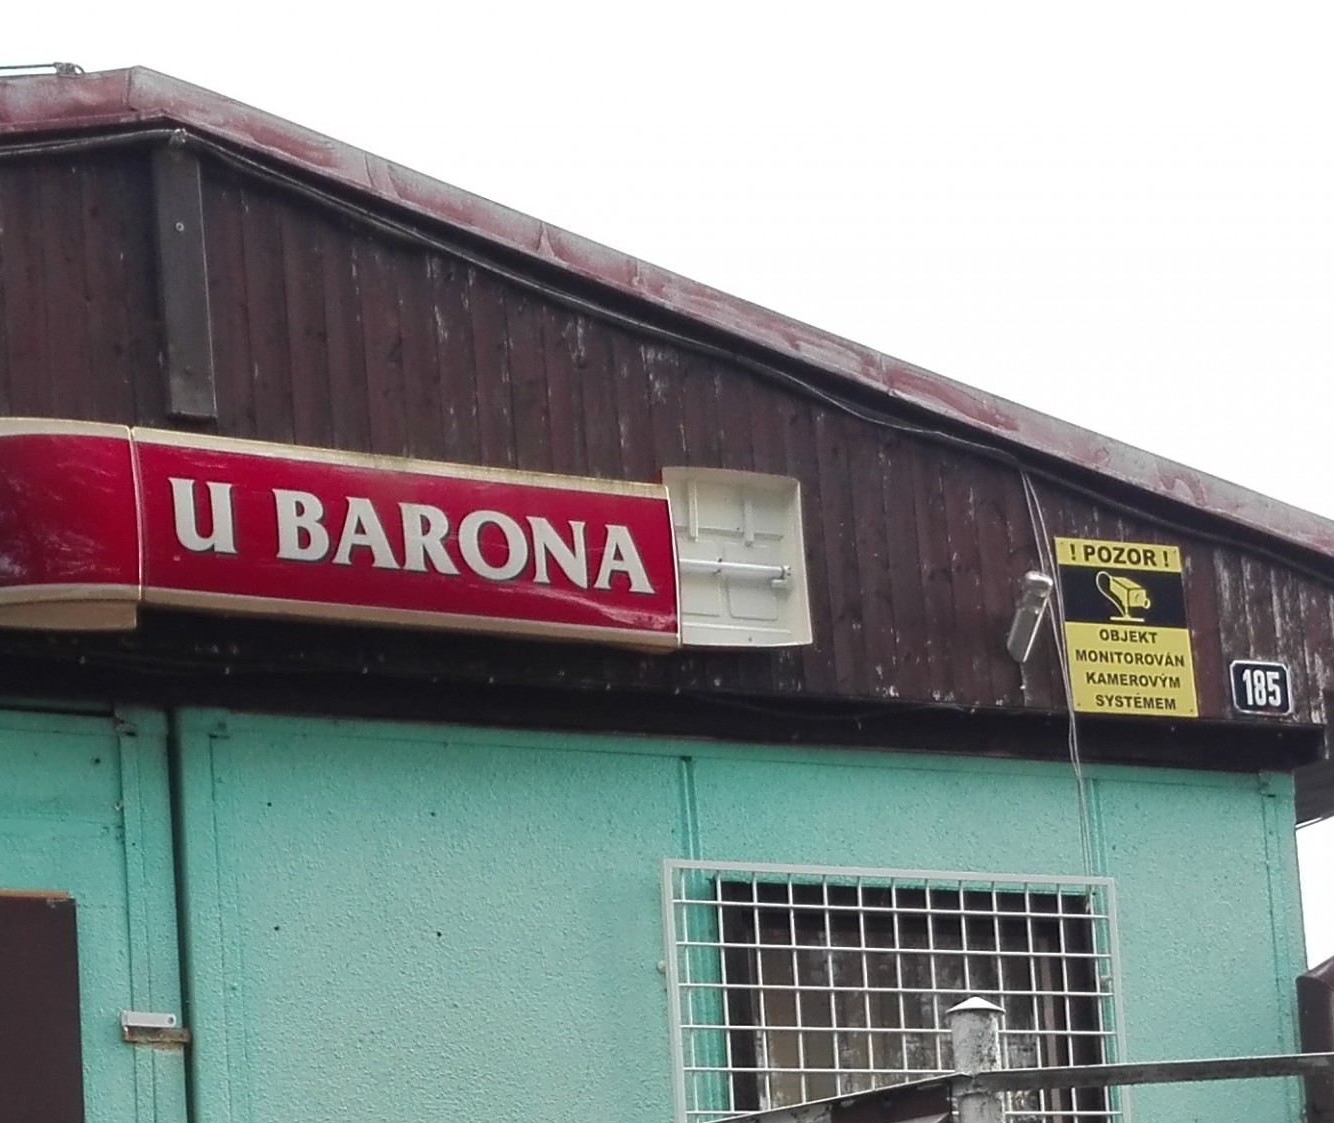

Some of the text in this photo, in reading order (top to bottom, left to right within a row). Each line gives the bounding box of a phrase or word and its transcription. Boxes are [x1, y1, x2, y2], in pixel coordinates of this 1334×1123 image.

[168, 476, 656, 595] U BARONA
[1083, 544, 1158, 567] POZOR
[1098, 628, 1158, 644] OBJEKT
[1075, 648, 1185, 668] MONITOROVÁN
[1085, 670, 1181, 689] KAMEROVÝM
[1242, 668, 1282, 707] 185
[1095, 692, 1177, 710] SYSTÉMEM
